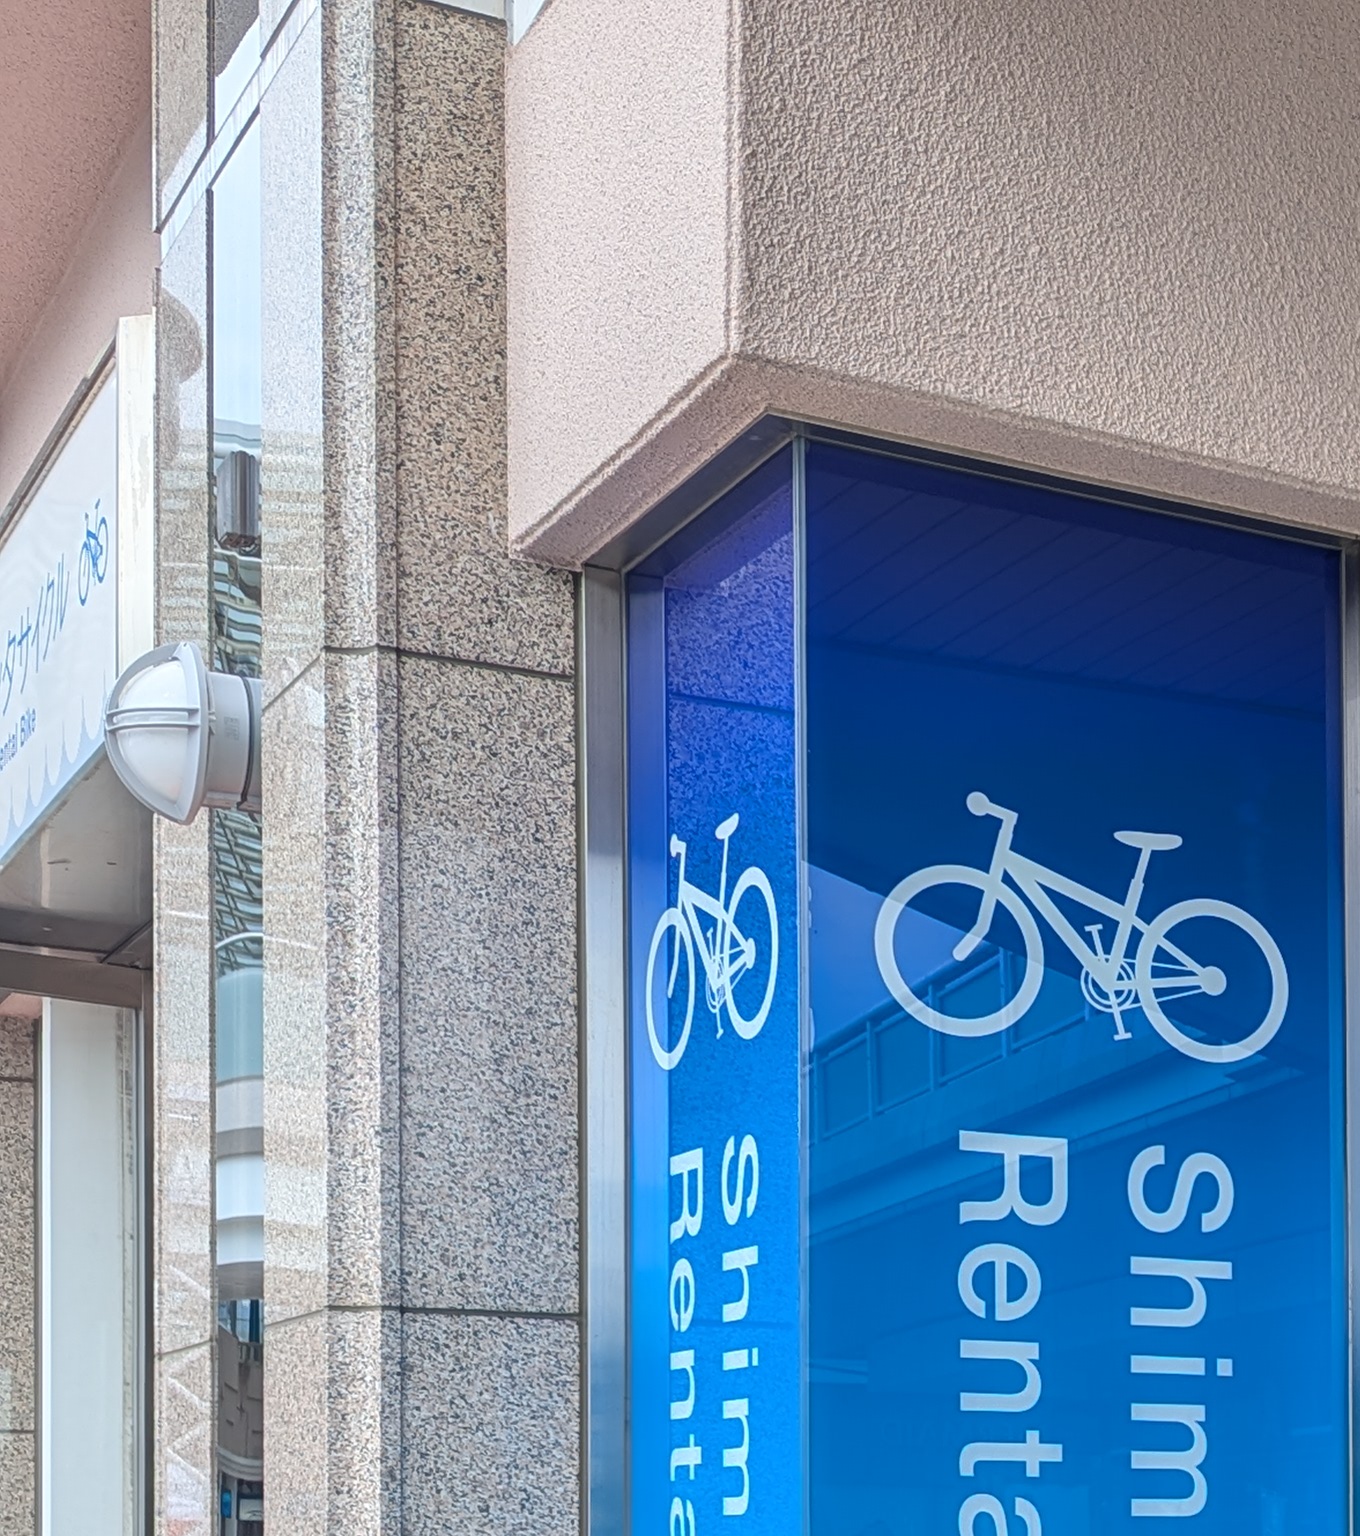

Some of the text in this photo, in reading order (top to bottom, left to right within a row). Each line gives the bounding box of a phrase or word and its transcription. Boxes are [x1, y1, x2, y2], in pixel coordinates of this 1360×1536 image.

[0, 553, 70, 717] タサイクル
[20, 707, 37, 747] Bike
